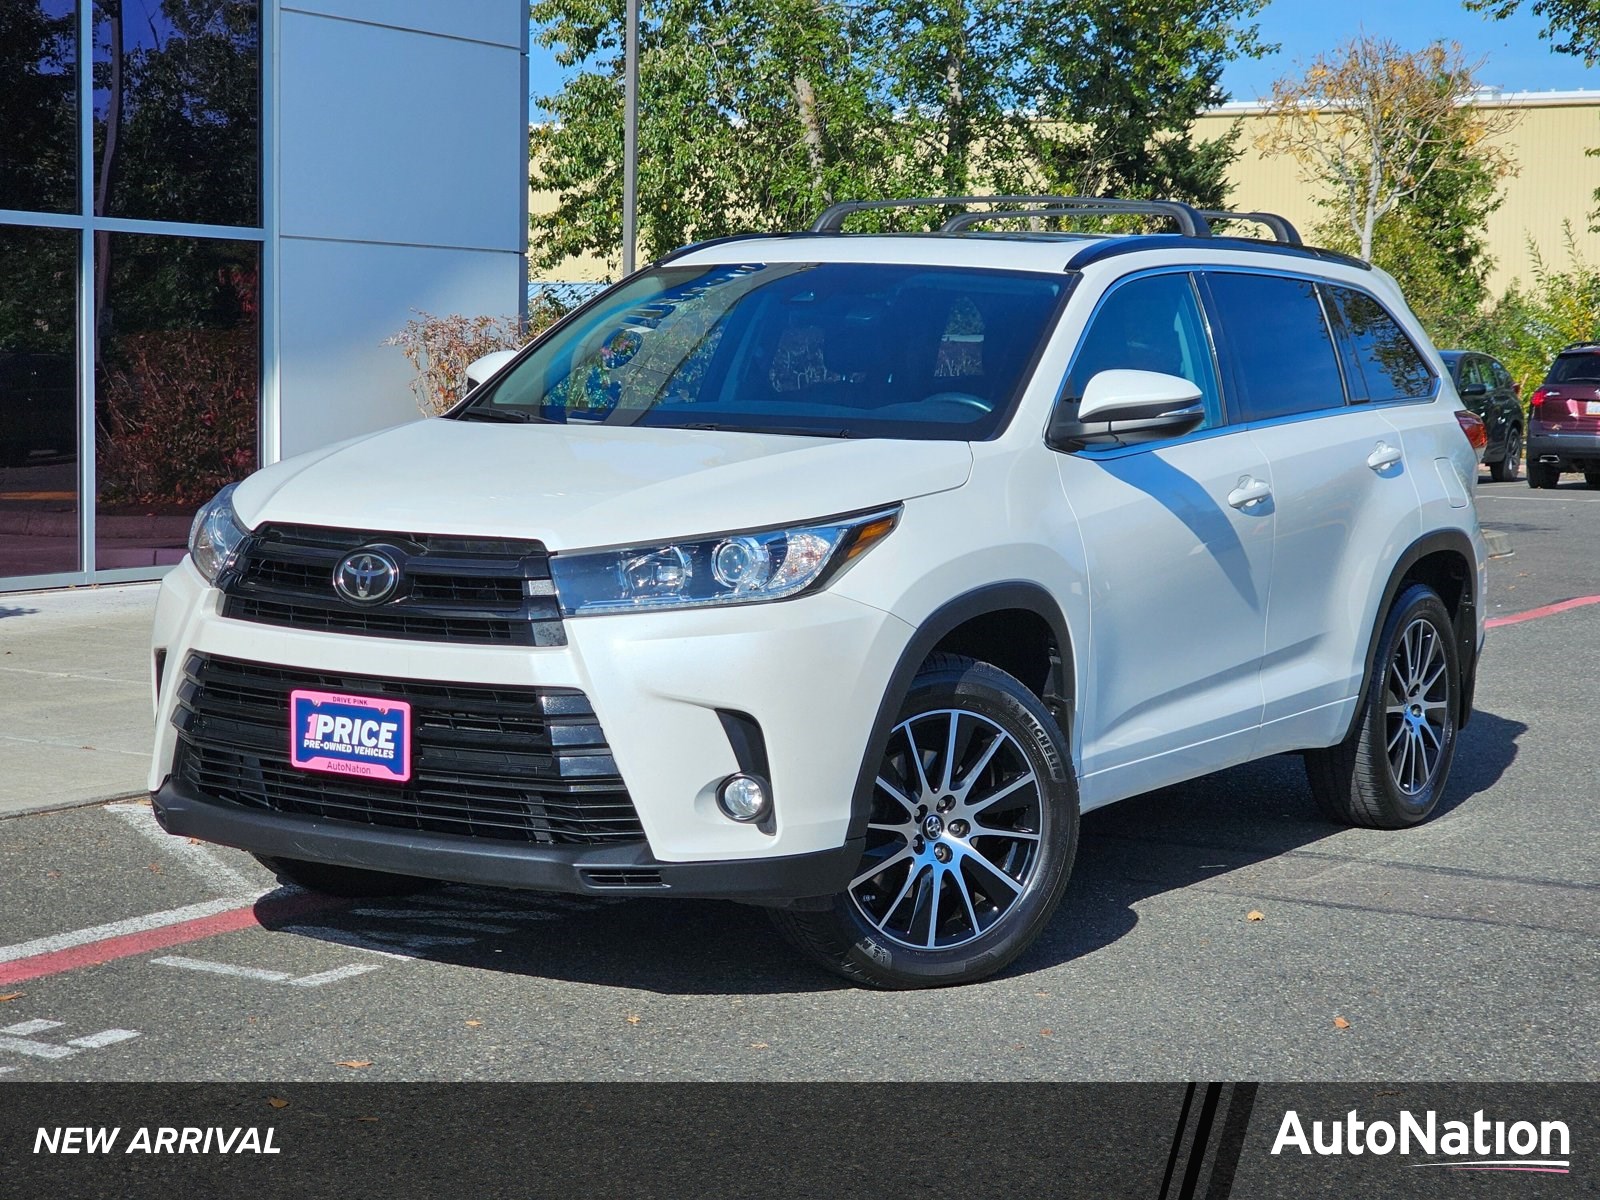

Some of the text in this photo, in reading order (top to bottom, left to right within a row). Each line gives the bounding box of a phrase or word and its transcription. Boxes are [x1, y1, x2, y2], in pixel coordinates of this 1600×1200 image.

[332, 696, 368, 706] DRIVE PINK
[303, 739, 394, 759] PRE-OWNED VEHICLES
[326, 761, 371, 775] AutoNation
